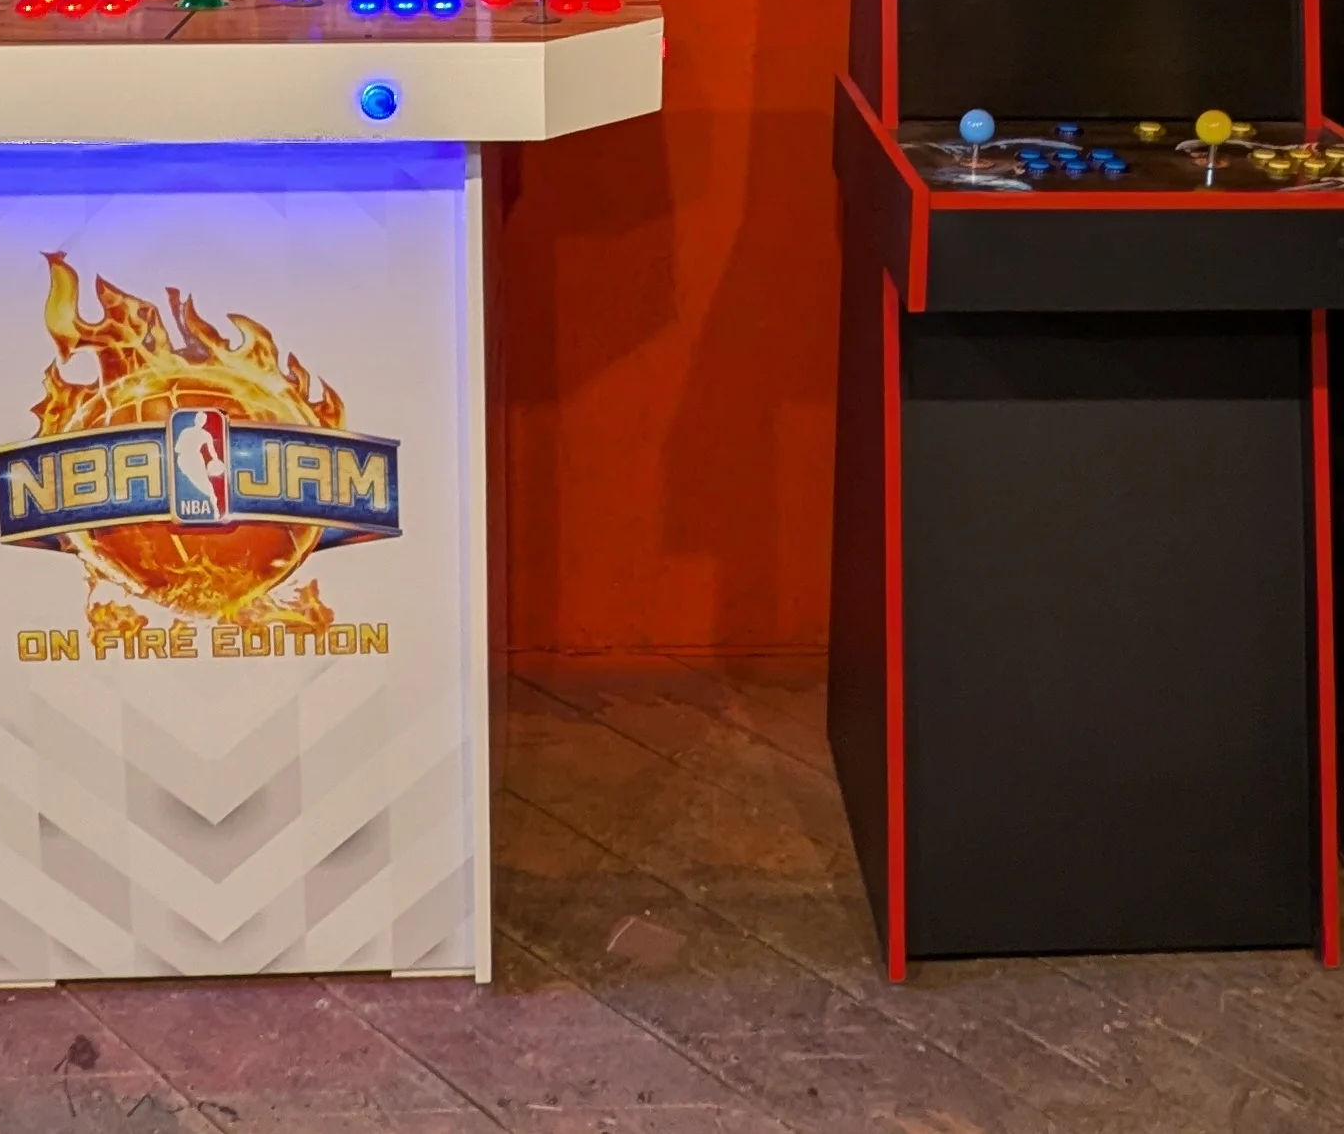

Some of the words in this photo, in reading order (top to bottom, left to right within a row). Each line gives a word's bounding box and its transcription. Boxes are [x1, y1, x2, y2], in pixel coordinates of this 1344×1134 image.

[8, 441, 165, 519] NBA
[236, 441, 389, 512] JAM
[181, 500, 212, 516] NBA
[17, 630, 80, 662] ON
[95, 626, 198, 661] FIRE
[212, 623, 389, 657] EDITION
